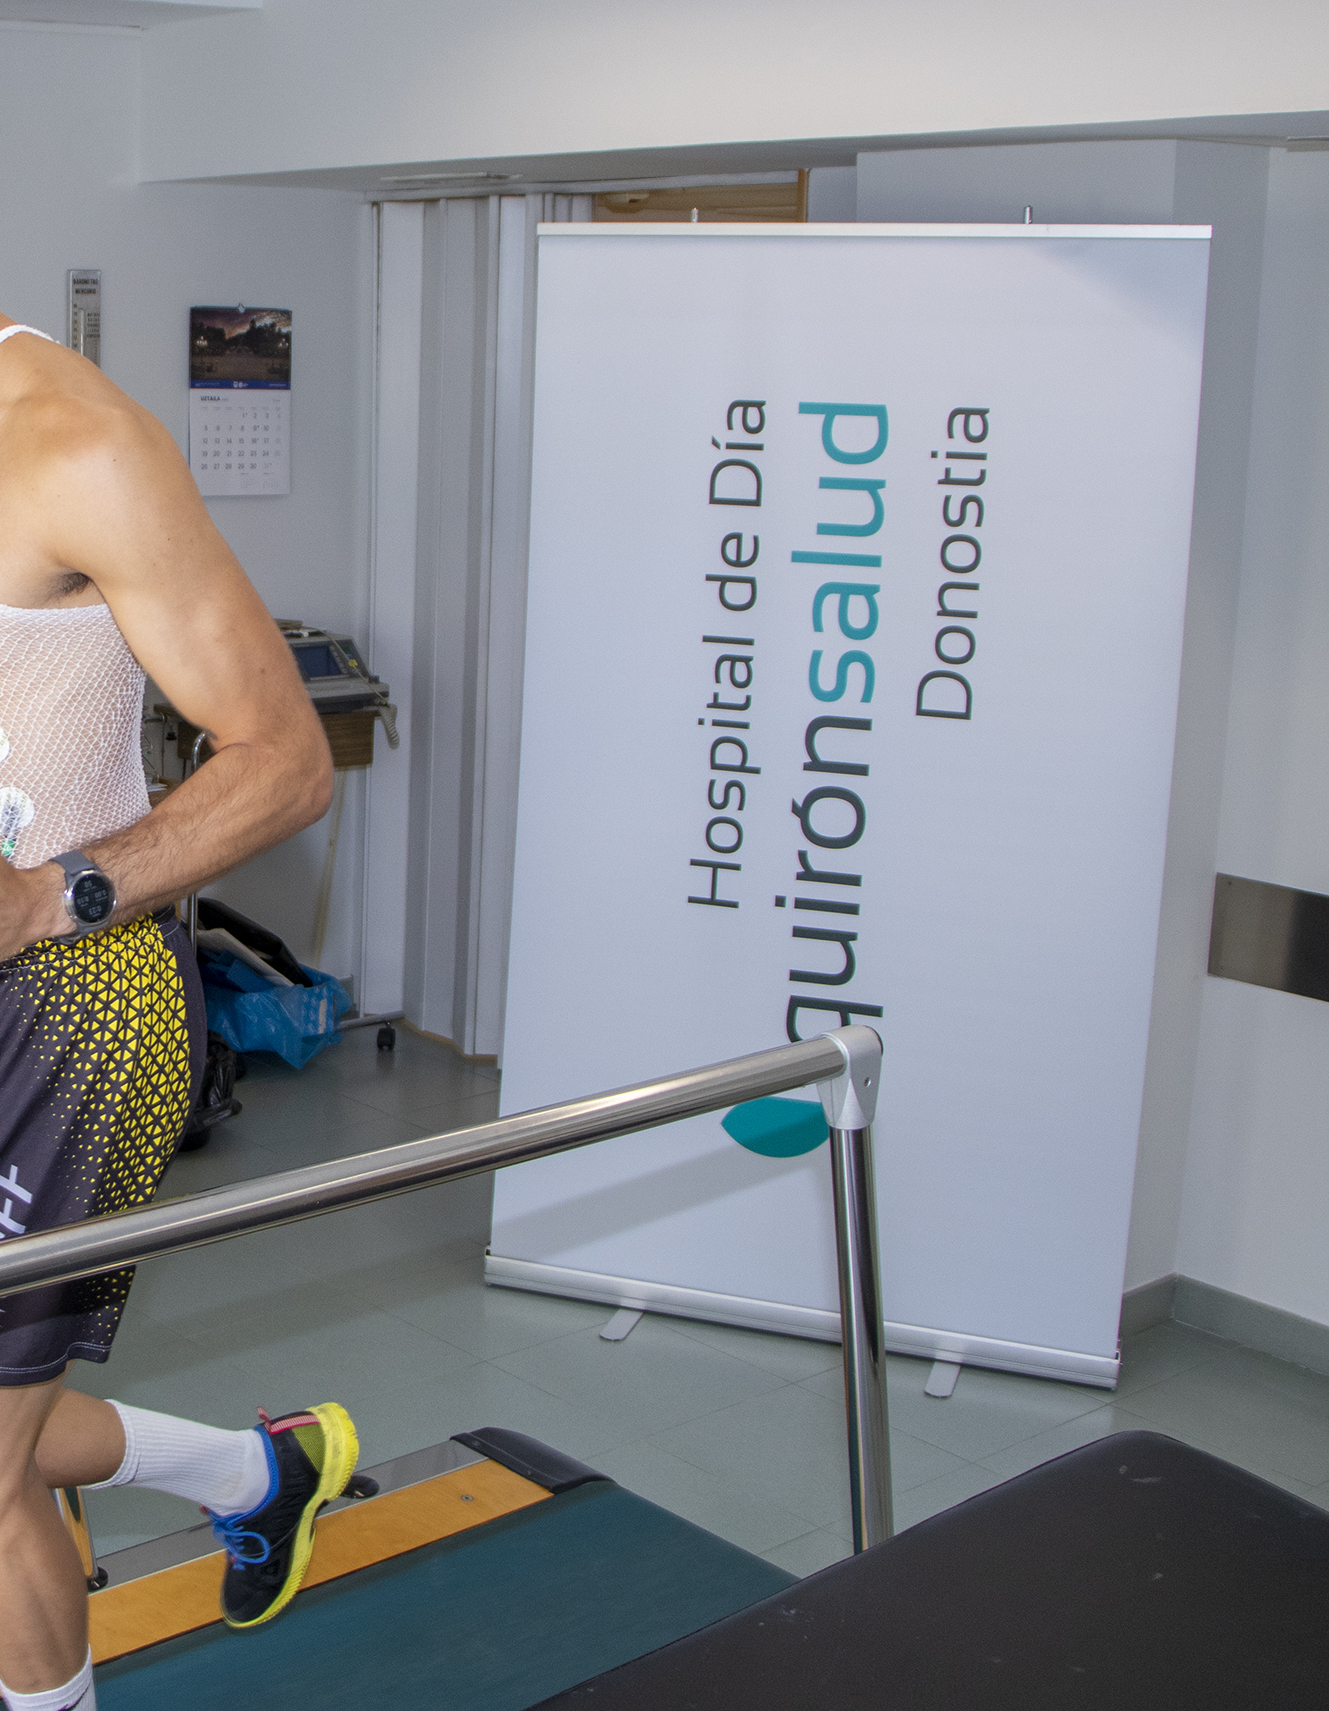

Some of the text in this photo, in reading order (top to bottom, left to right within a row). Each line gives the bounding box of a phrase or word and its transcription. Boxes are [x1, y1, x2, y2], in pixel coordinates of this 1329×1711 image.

[686, 399, 767, 910] Hospital de Día
[774, 401, 889, 1043] quirónsalud
[915, 406, 990, 722] Donostia
